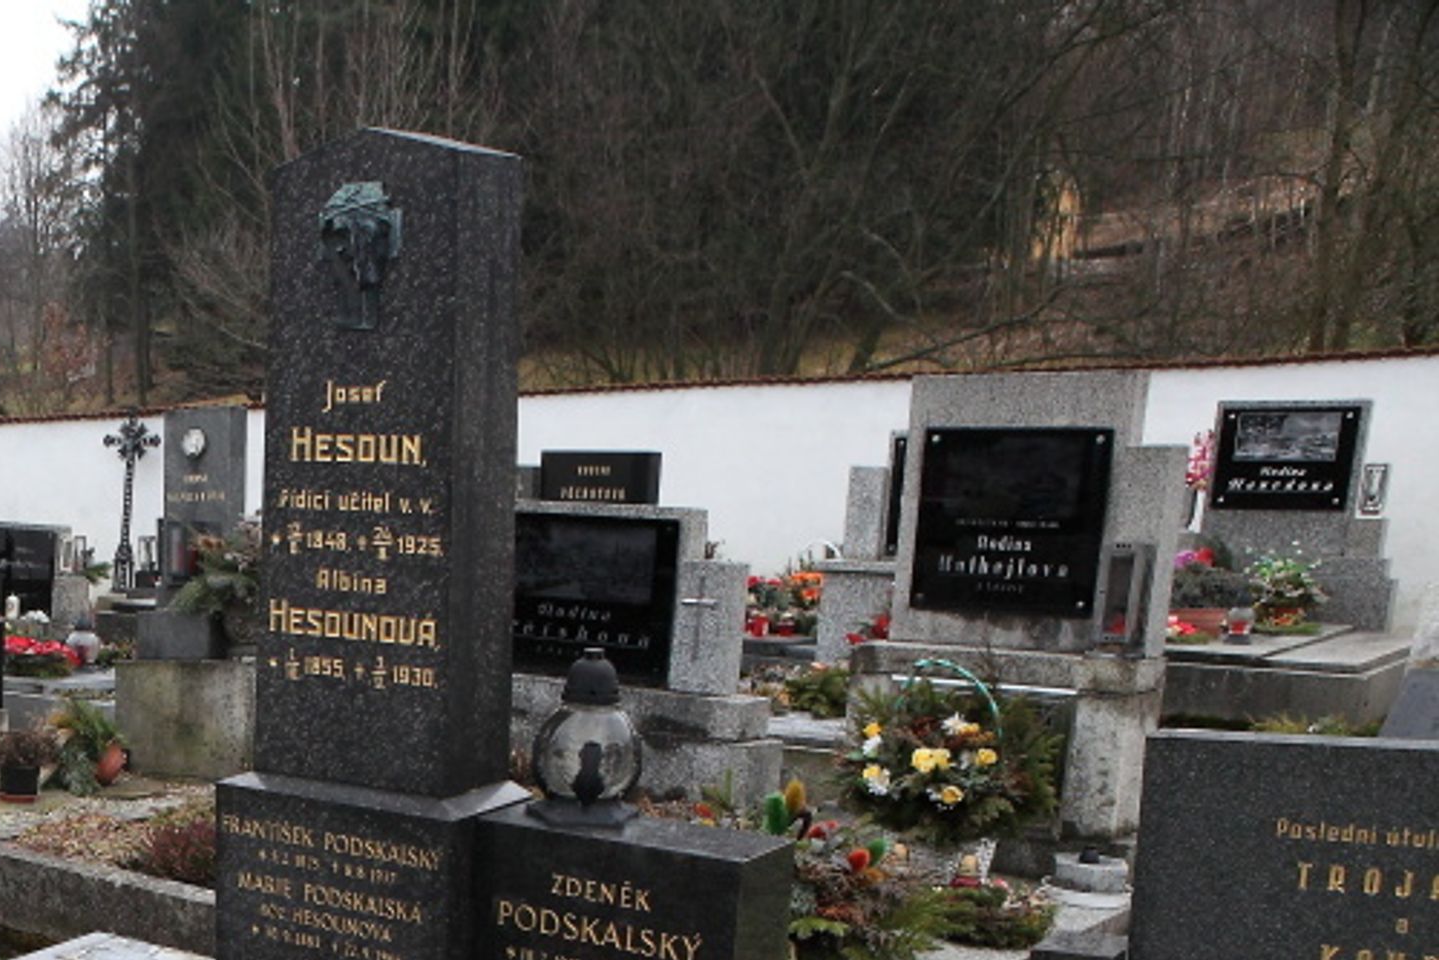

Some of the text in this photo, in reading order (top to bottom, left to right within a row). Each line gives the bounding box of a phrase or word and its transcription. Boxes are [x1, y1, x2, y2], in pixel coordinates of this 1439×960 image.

[322, 379, 387, 413] Josef
[316, 568, 388, 595] Albina
[551, 871, 652, 914] ZDENĚK
[1395, 917, 1410, 934] a
